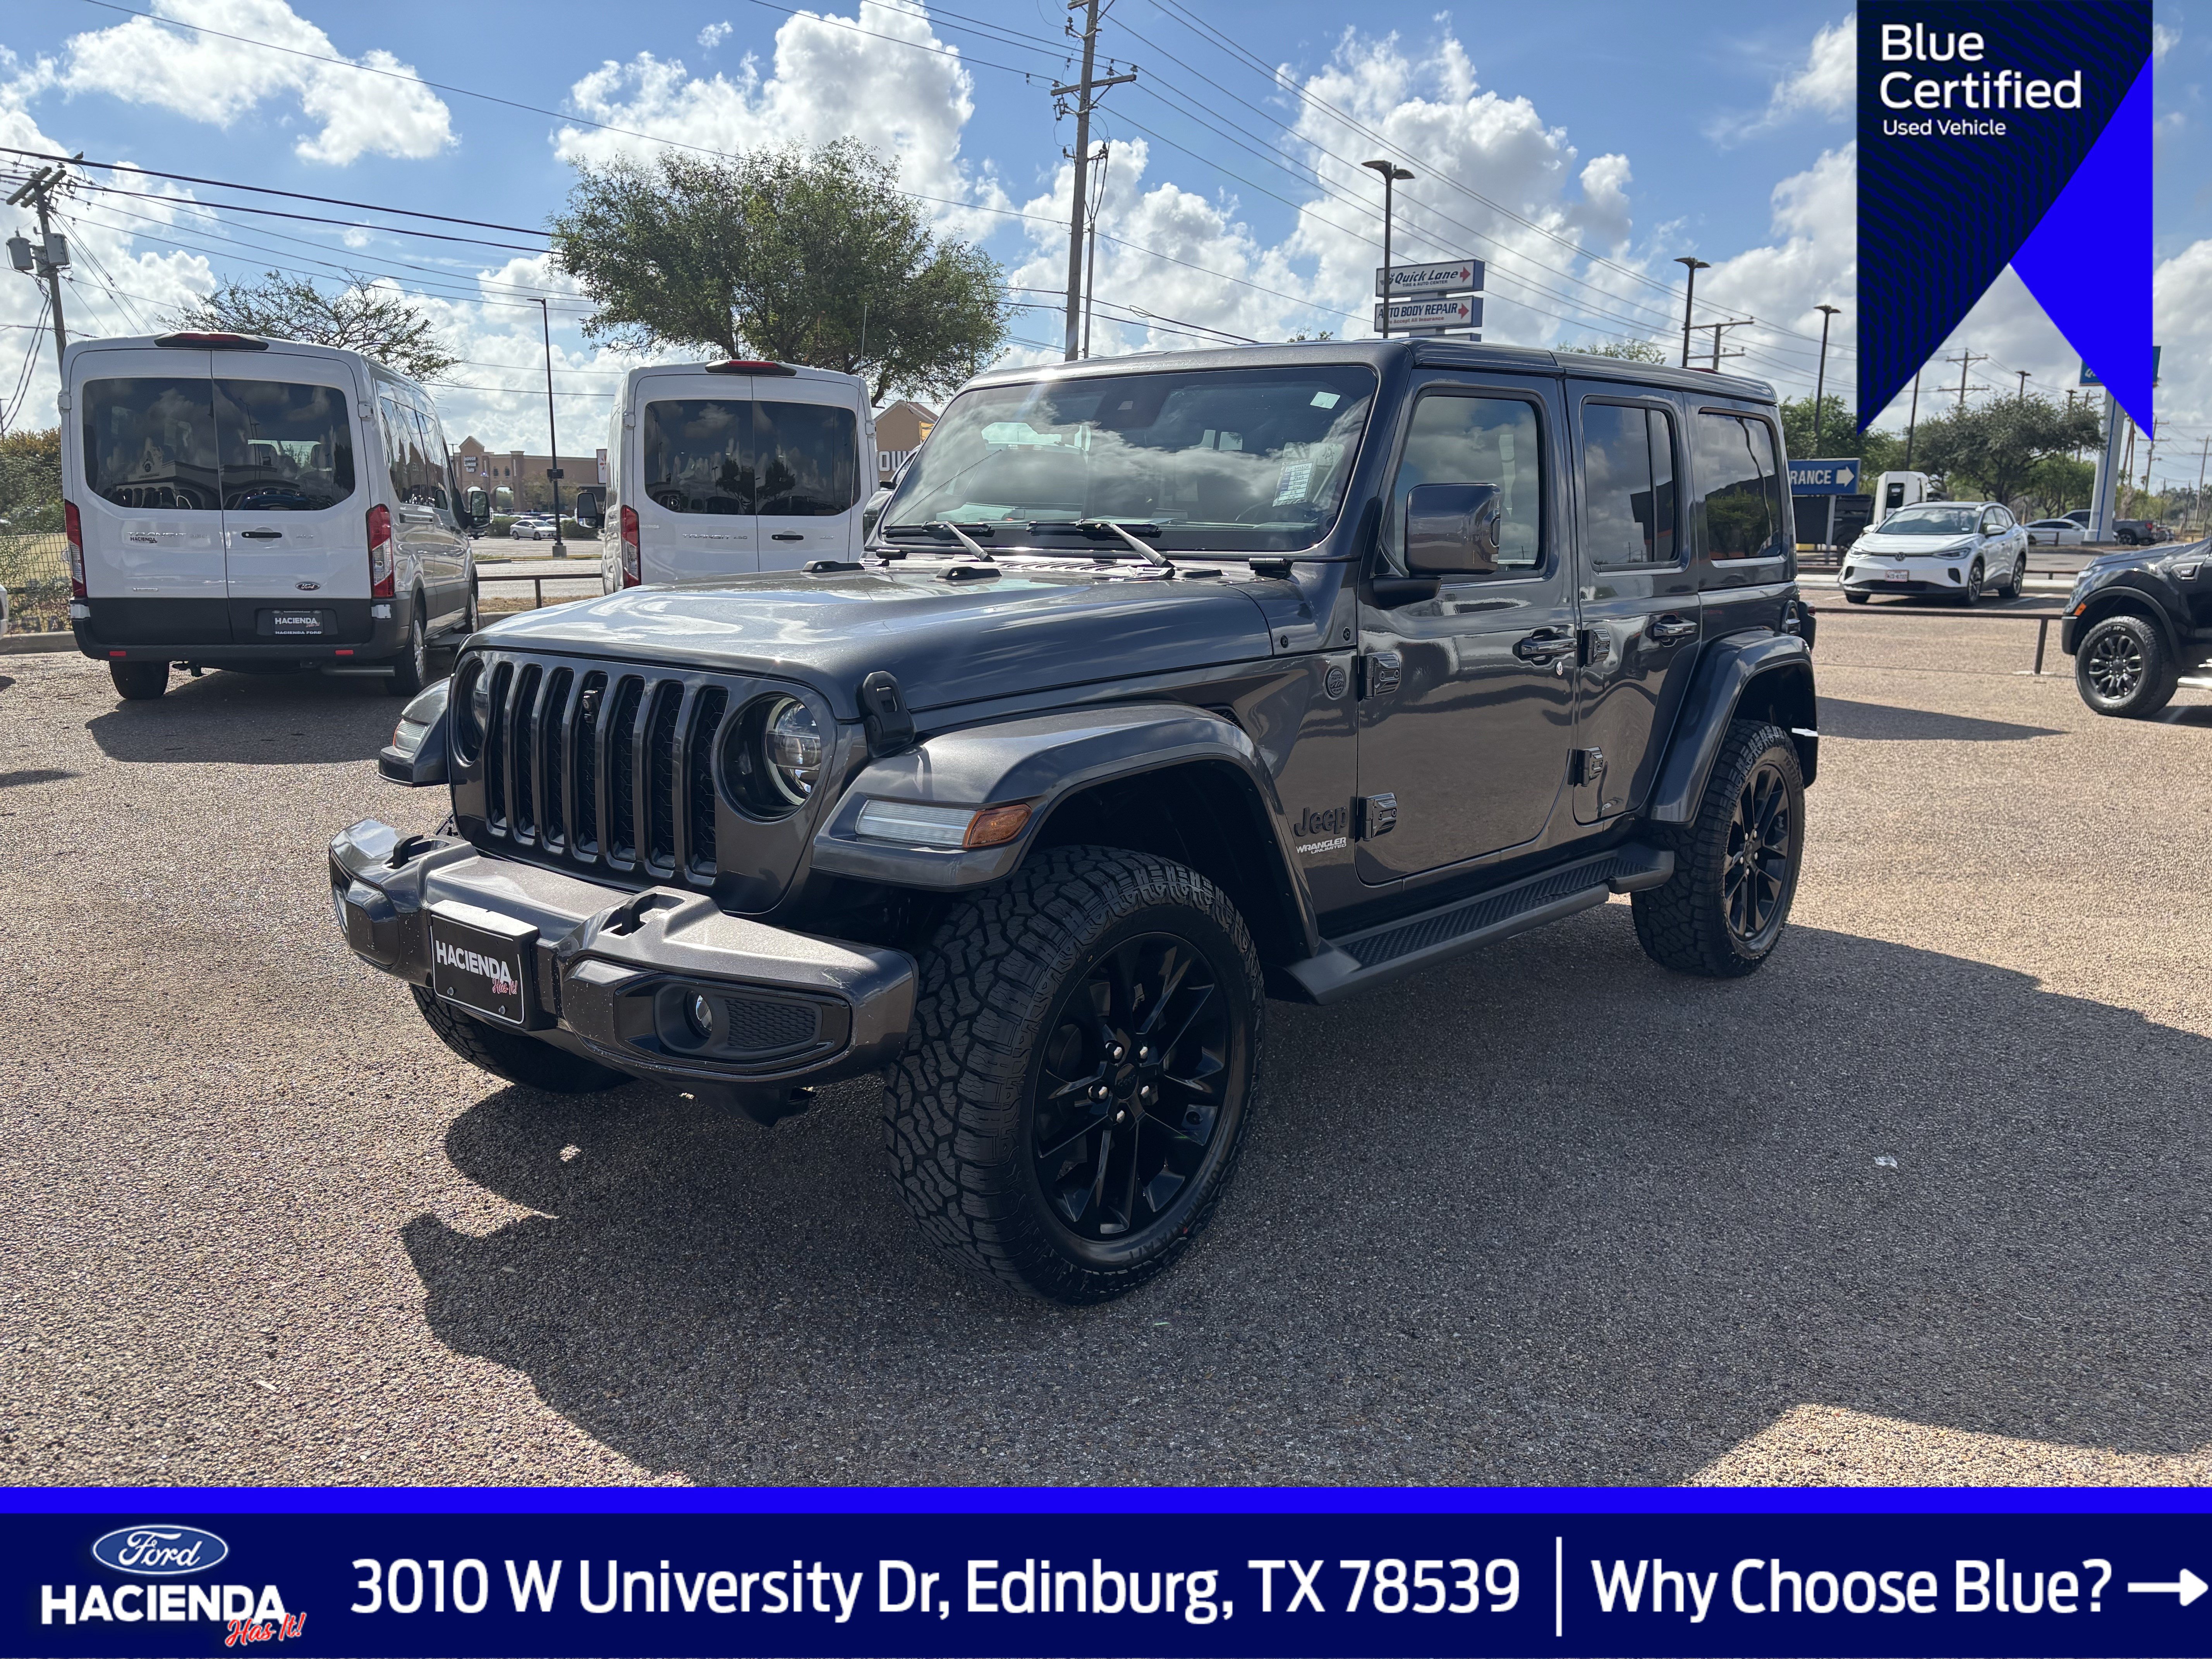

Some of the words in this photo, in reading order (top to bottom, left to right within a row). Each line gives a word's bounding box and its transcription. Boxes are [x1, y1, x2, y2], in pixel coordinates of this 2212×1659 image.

[1395, 271, 1427, 284] Quick
[1428, 270, 1458, 280] Lane
[1377, 307, 1399, 319] ATO
[1401, 305, 1424, 317] BODY
[1425, 303, 1458, 315] REPAIR
[1790, 470, 1832, 485] RANCE
[1294, 807, 1348, 837] Jeep
[1296, 837, 1347, 854] WRANGLER
[1311, 843, 1347, 854] UNLIMITED
[435, 940, 512, 985] HACIENDA
